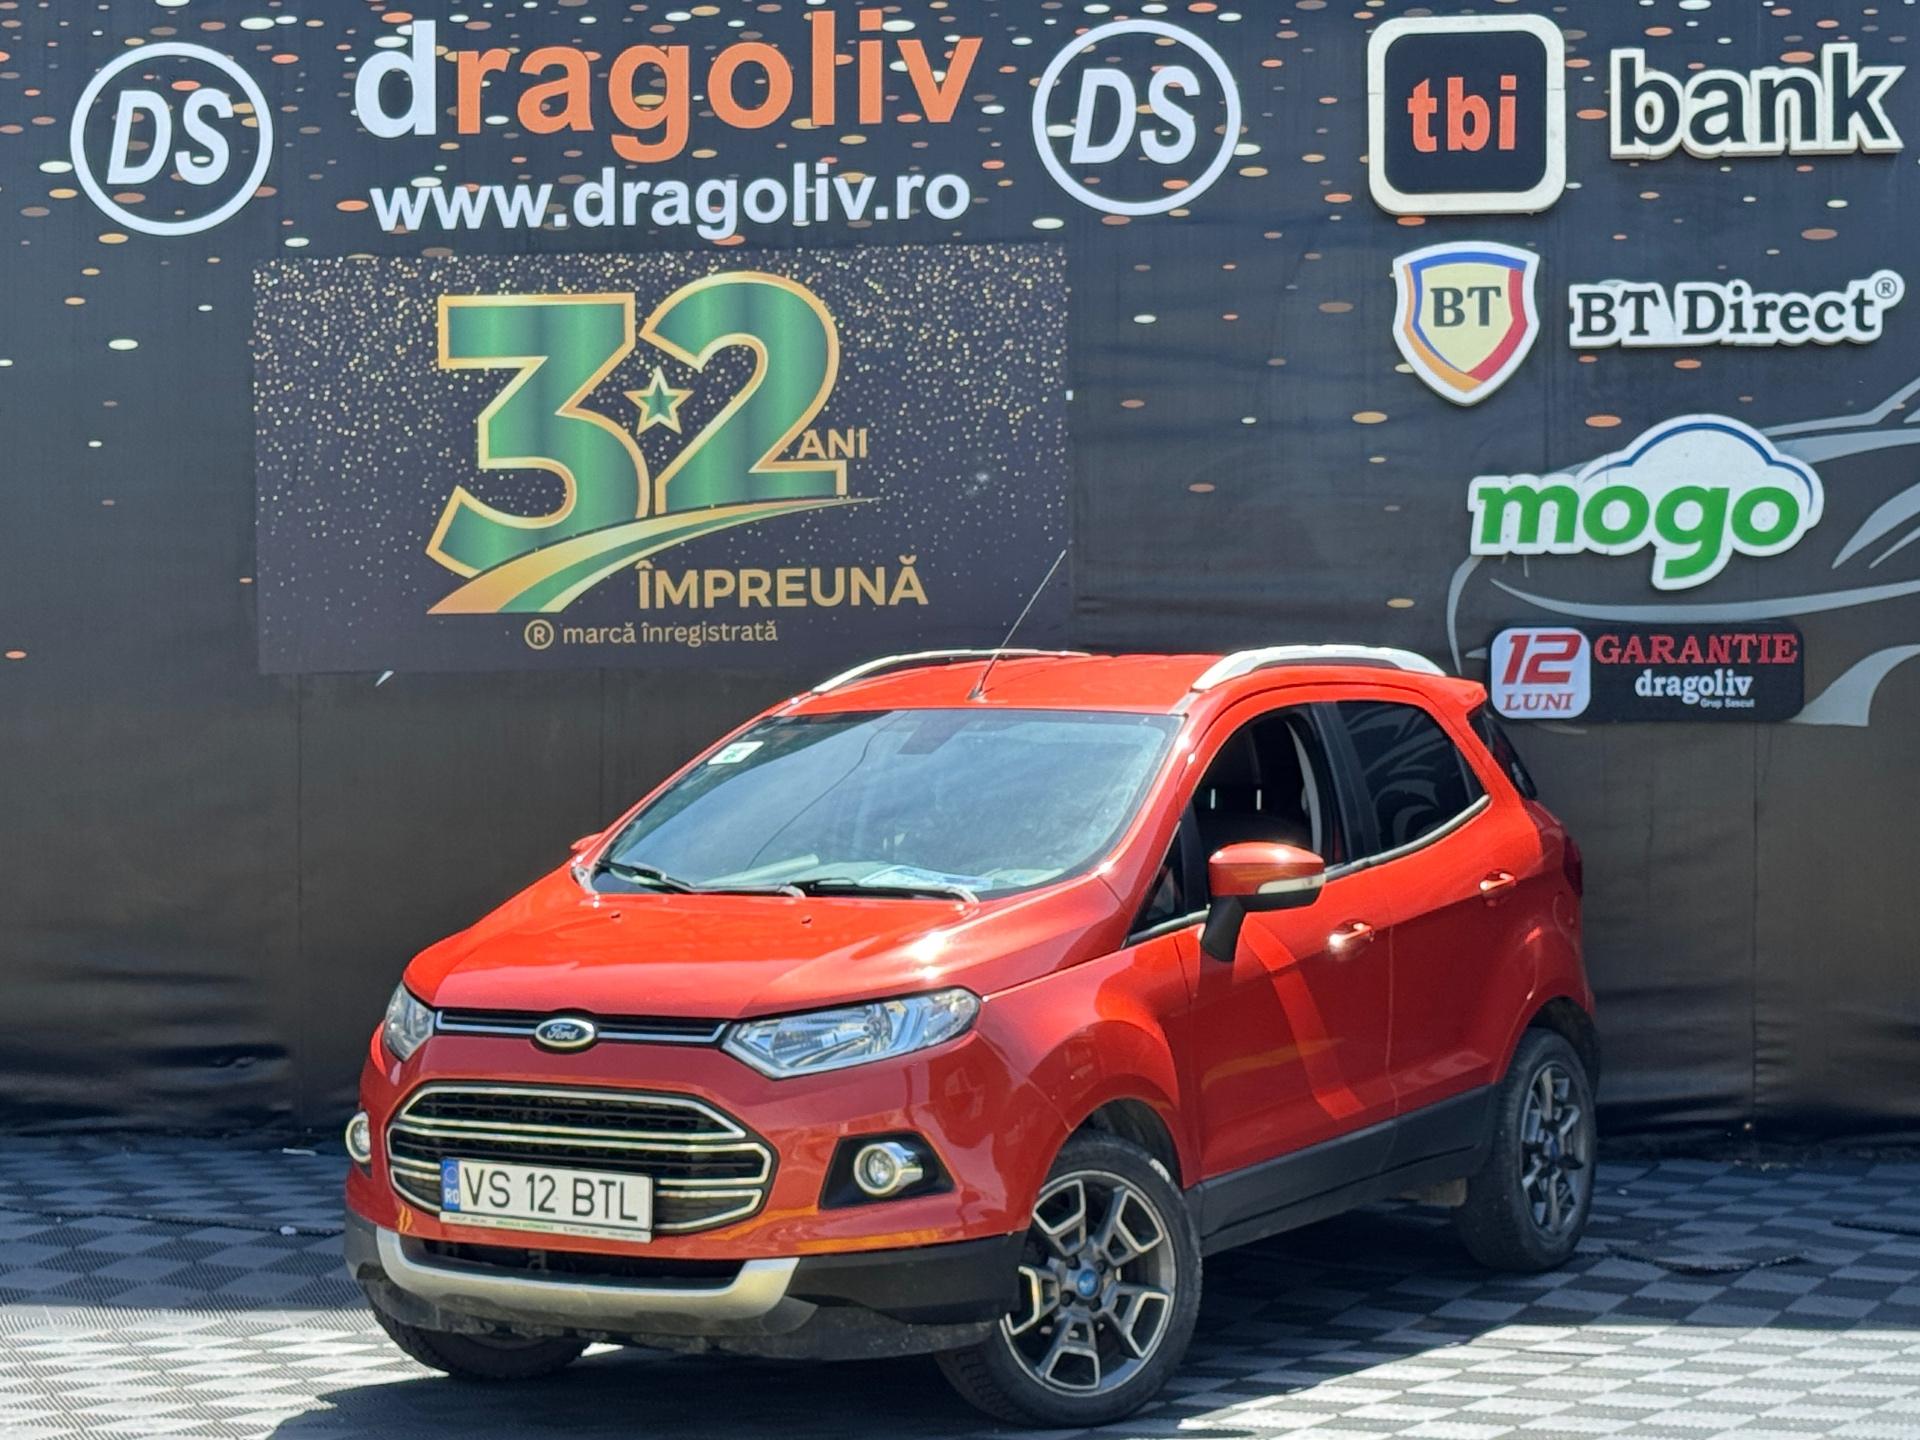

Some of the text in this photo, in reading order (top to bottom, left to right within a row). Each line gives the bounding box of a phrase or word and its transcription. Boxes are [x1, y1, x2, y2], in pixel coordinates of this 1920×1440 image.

[354, 10, 983, 163] dragoliv
[1612, 44, 1904, 157] bank
[106, 87, 234, 186] DS
[1070, 65, 1201, 165] DS
[1407, 75, 1516, 153] tbi
[369, 162, 971, 240] www.dragoliv.ro
[1430, 286, 1502, 327] BT
[1576, 290, 1661, 337] BT
[425, 271, 847, 578] 32
[796, 428, 868, 459] ANI
[1477, 485, 1800, 581] mogo
[637, 556, 929, 610] ÎMPREUNĂ
[562, 622, 636, 644] marcă
[642, 620, 779, 648] înregistrată
[1502, 634, 1582, 685] 12
[1594, 633, 1798, 664] GARANTIE
[1503, 693, 1573, 712] LUNI
[1635, 668, 1754, 705] dragoliv
[546, 1023, 580, 1040] Ford
[444, 1187, 459, 1204] RO
[463, 1166, 638, 1222] VS 12 BTL
